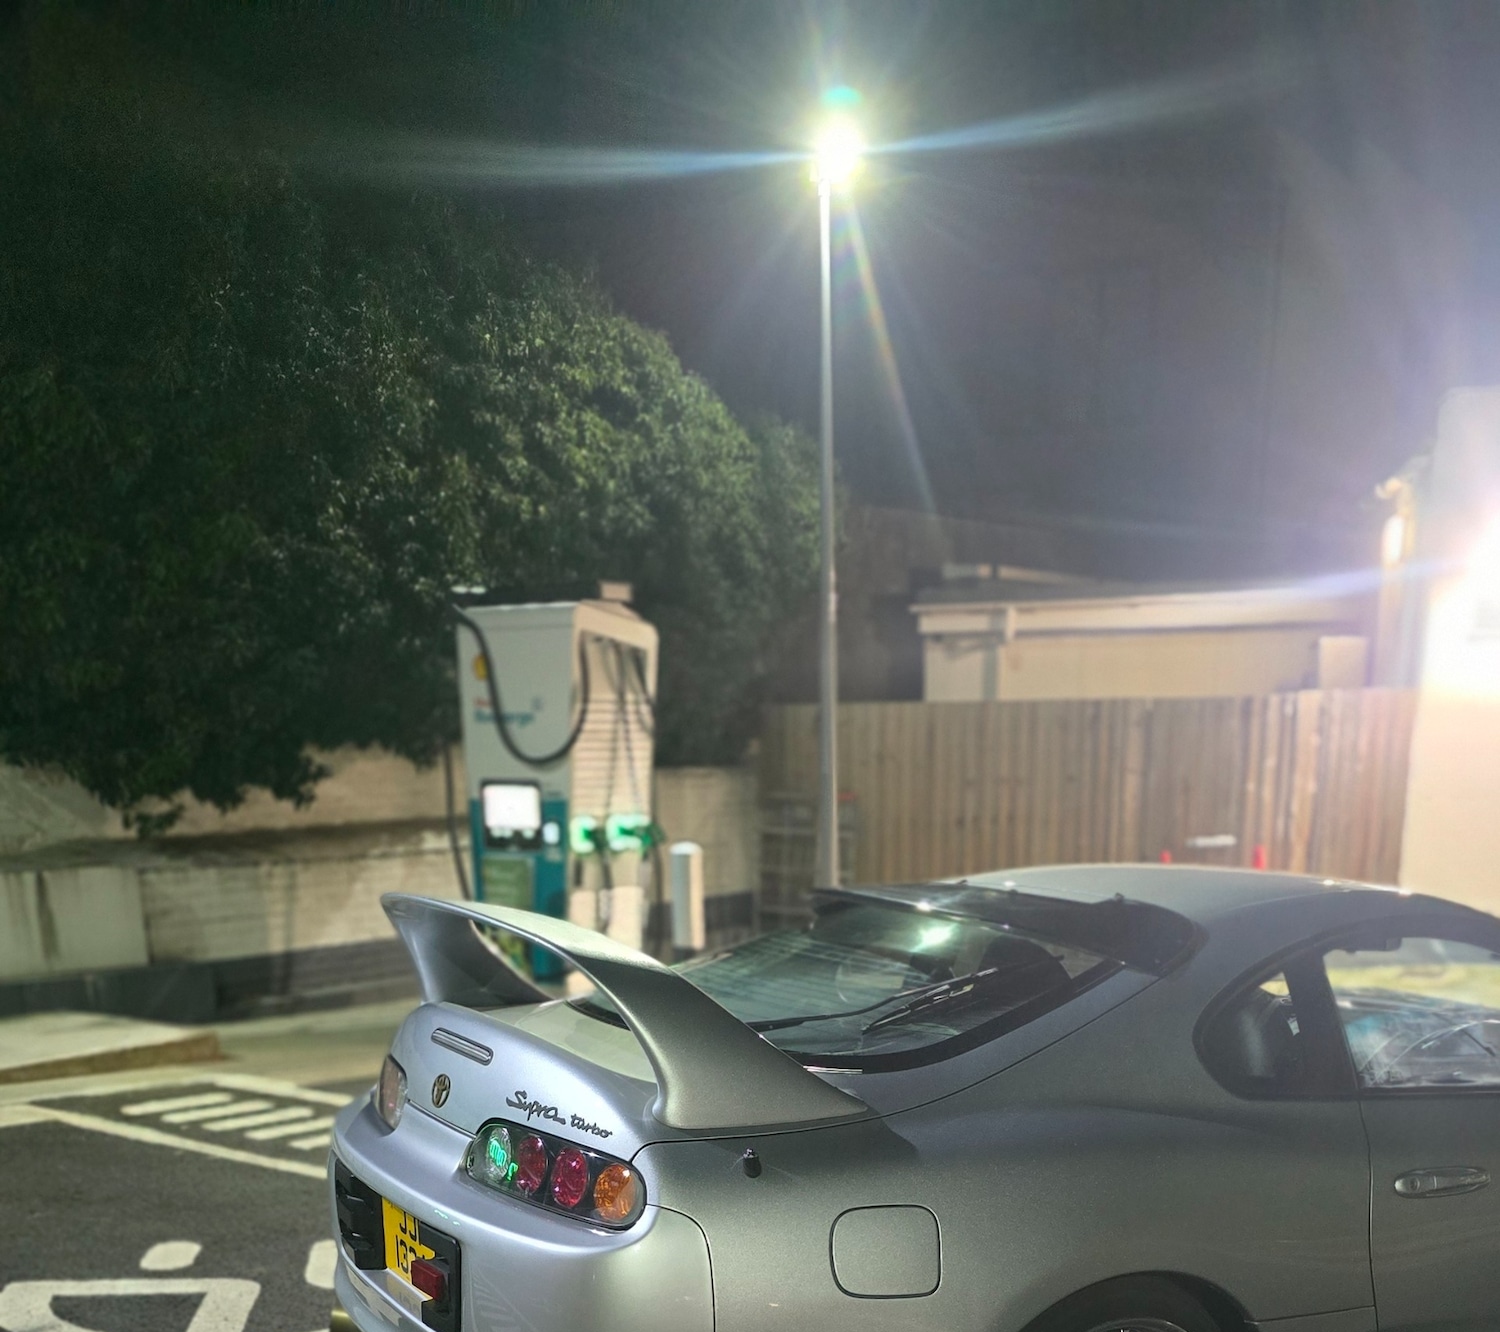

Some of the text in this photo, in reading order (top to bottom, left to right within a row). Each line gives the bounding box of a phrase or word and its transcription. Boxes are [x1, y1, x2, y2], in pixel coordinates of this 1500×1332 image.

[506, 1090, 613, 1138] Supra turbo
[395, 1234, 426, 1275] 13
